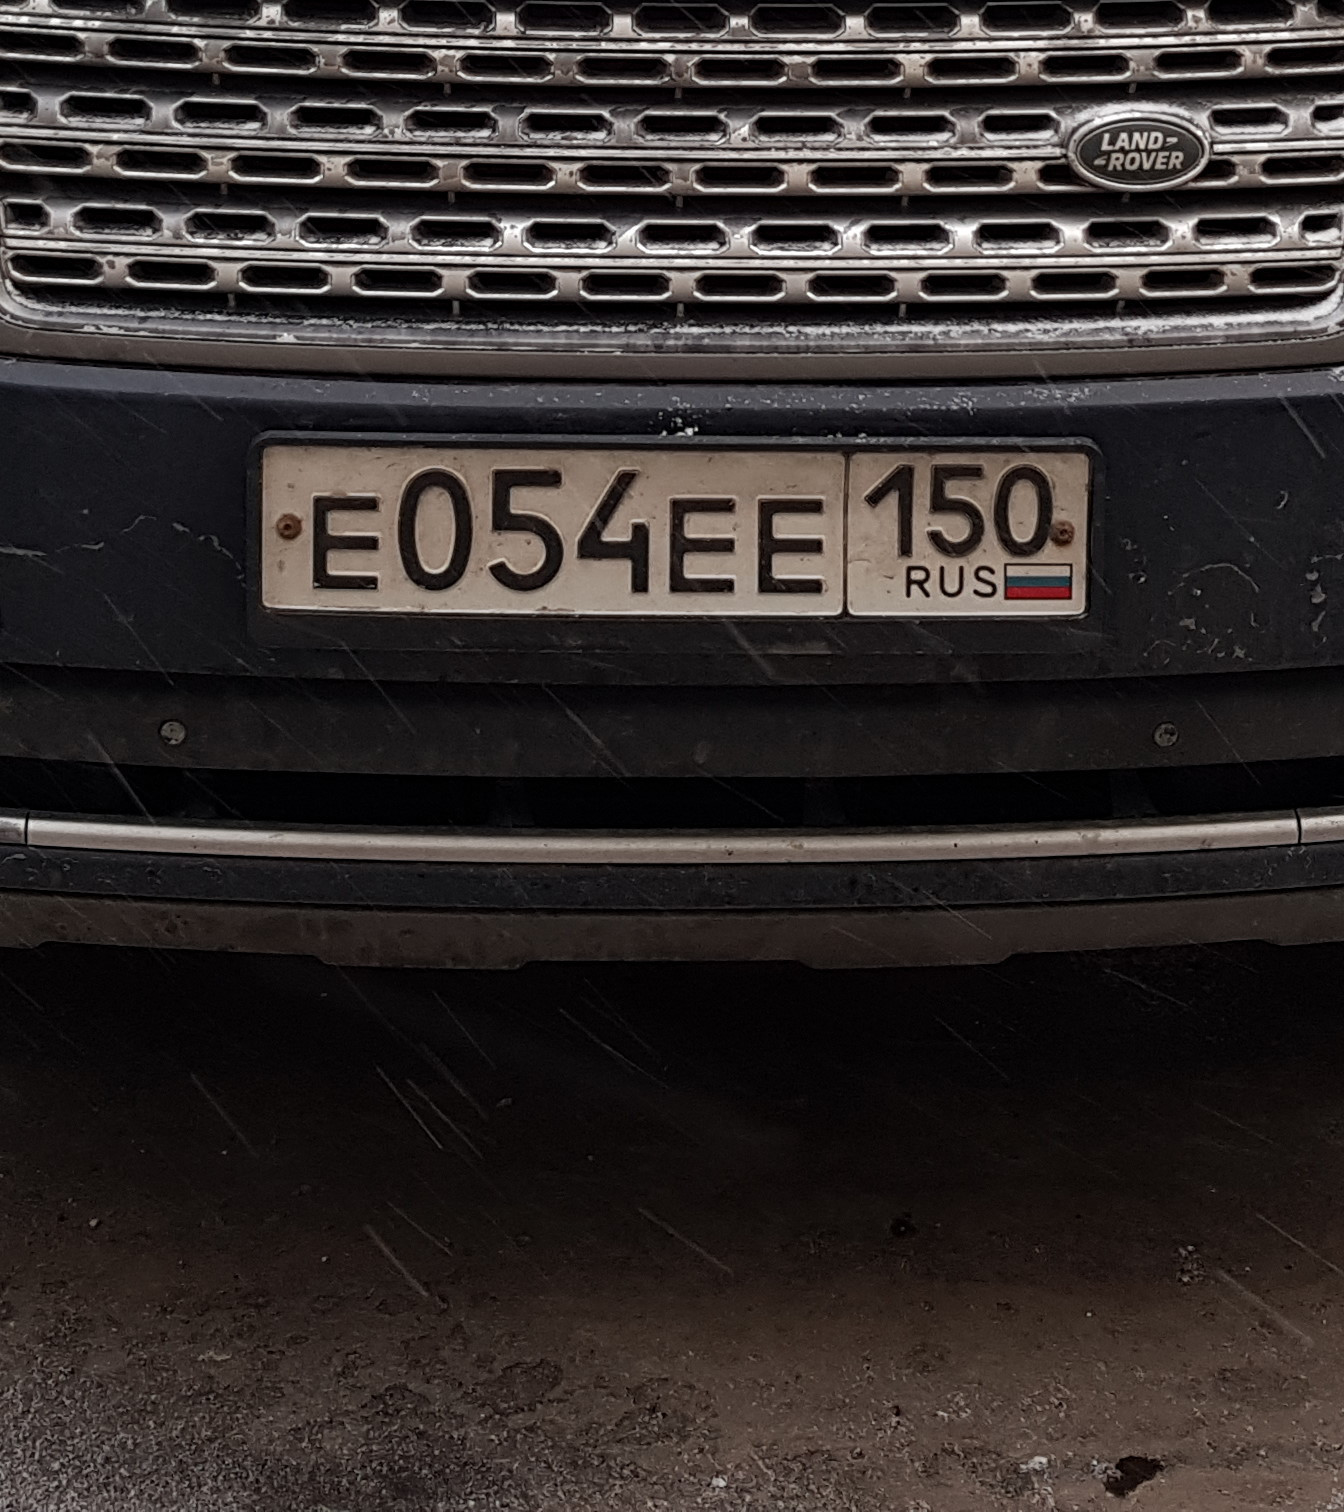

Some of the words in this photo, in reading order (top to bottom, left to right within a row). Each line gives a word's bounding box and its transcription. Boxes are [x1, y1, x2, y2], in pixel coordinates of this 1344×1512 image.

[1101, 131, 1163, 151] LAND
[1108, 151, 1184, 171] ROVER
[863, 463, 1054, 559] 150
[905, 565, 997, 599] RUS
